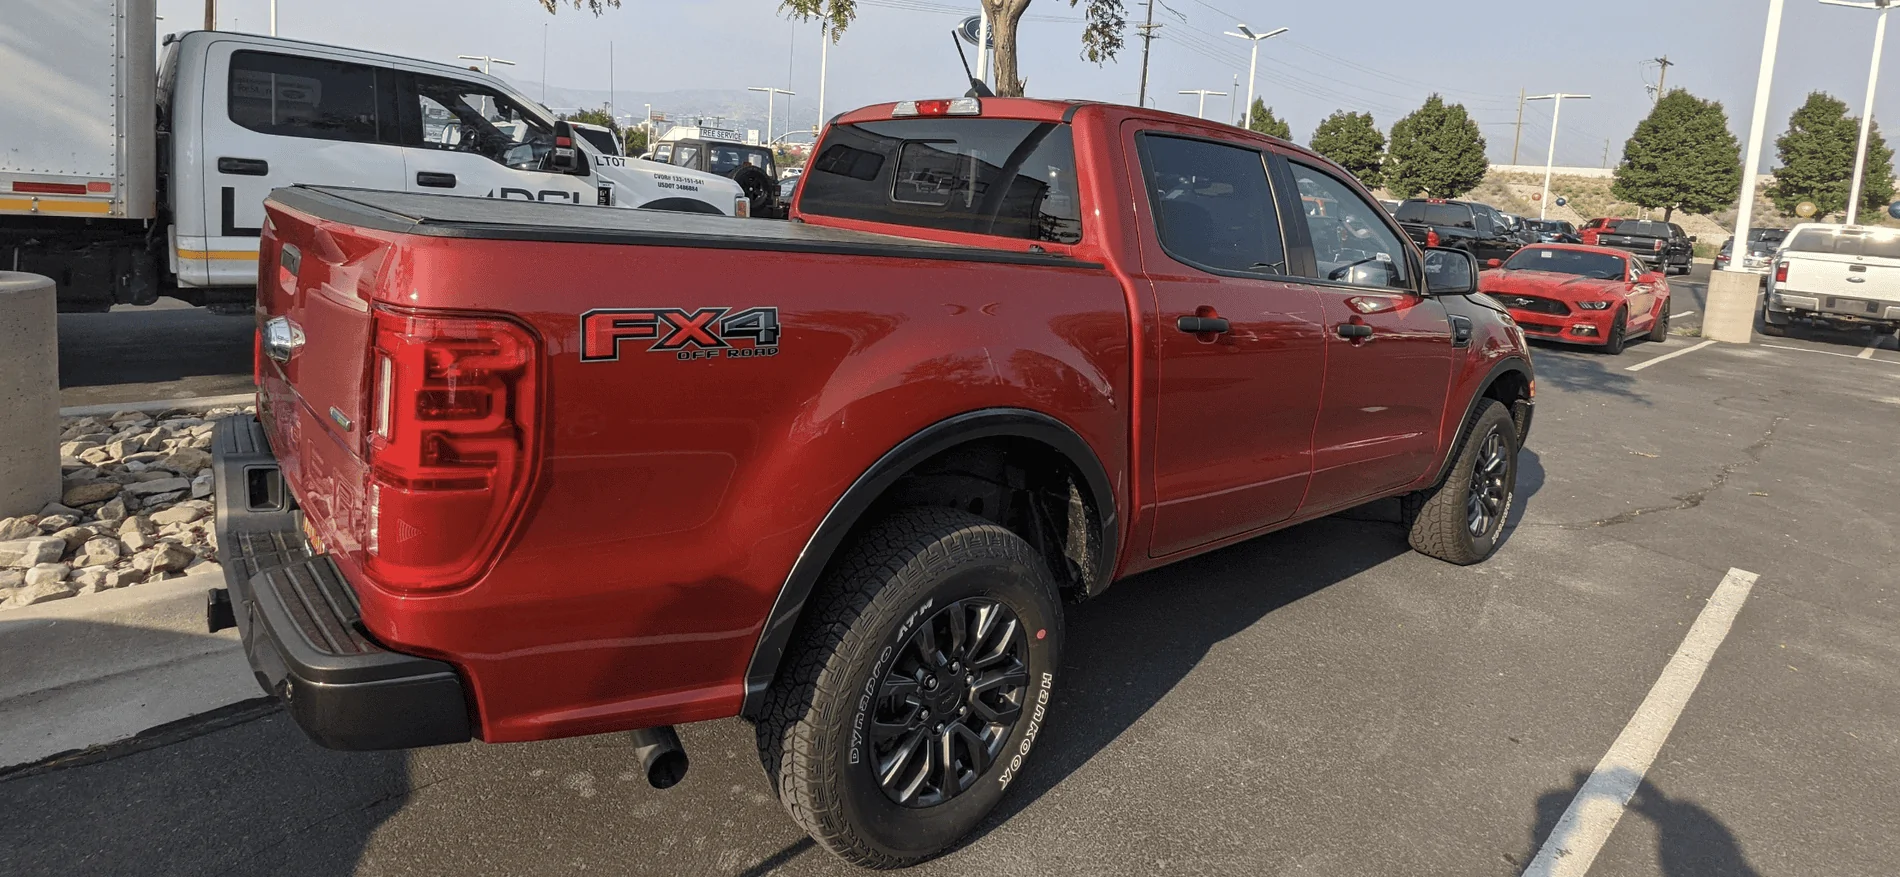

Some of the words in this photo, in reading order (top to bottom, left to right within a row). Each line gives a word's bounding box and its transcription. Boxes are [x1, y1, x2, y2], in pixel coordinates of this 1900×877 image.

[700, 129, 716, 137] TREE
[717, 130, 742, 140] SERVICE
[595, 156, 625, 167] LT07
[580, 307, 781, 362] FX4
[676, 349, 719, 360] OFF
[727, 347, 779, 358] ROAD
